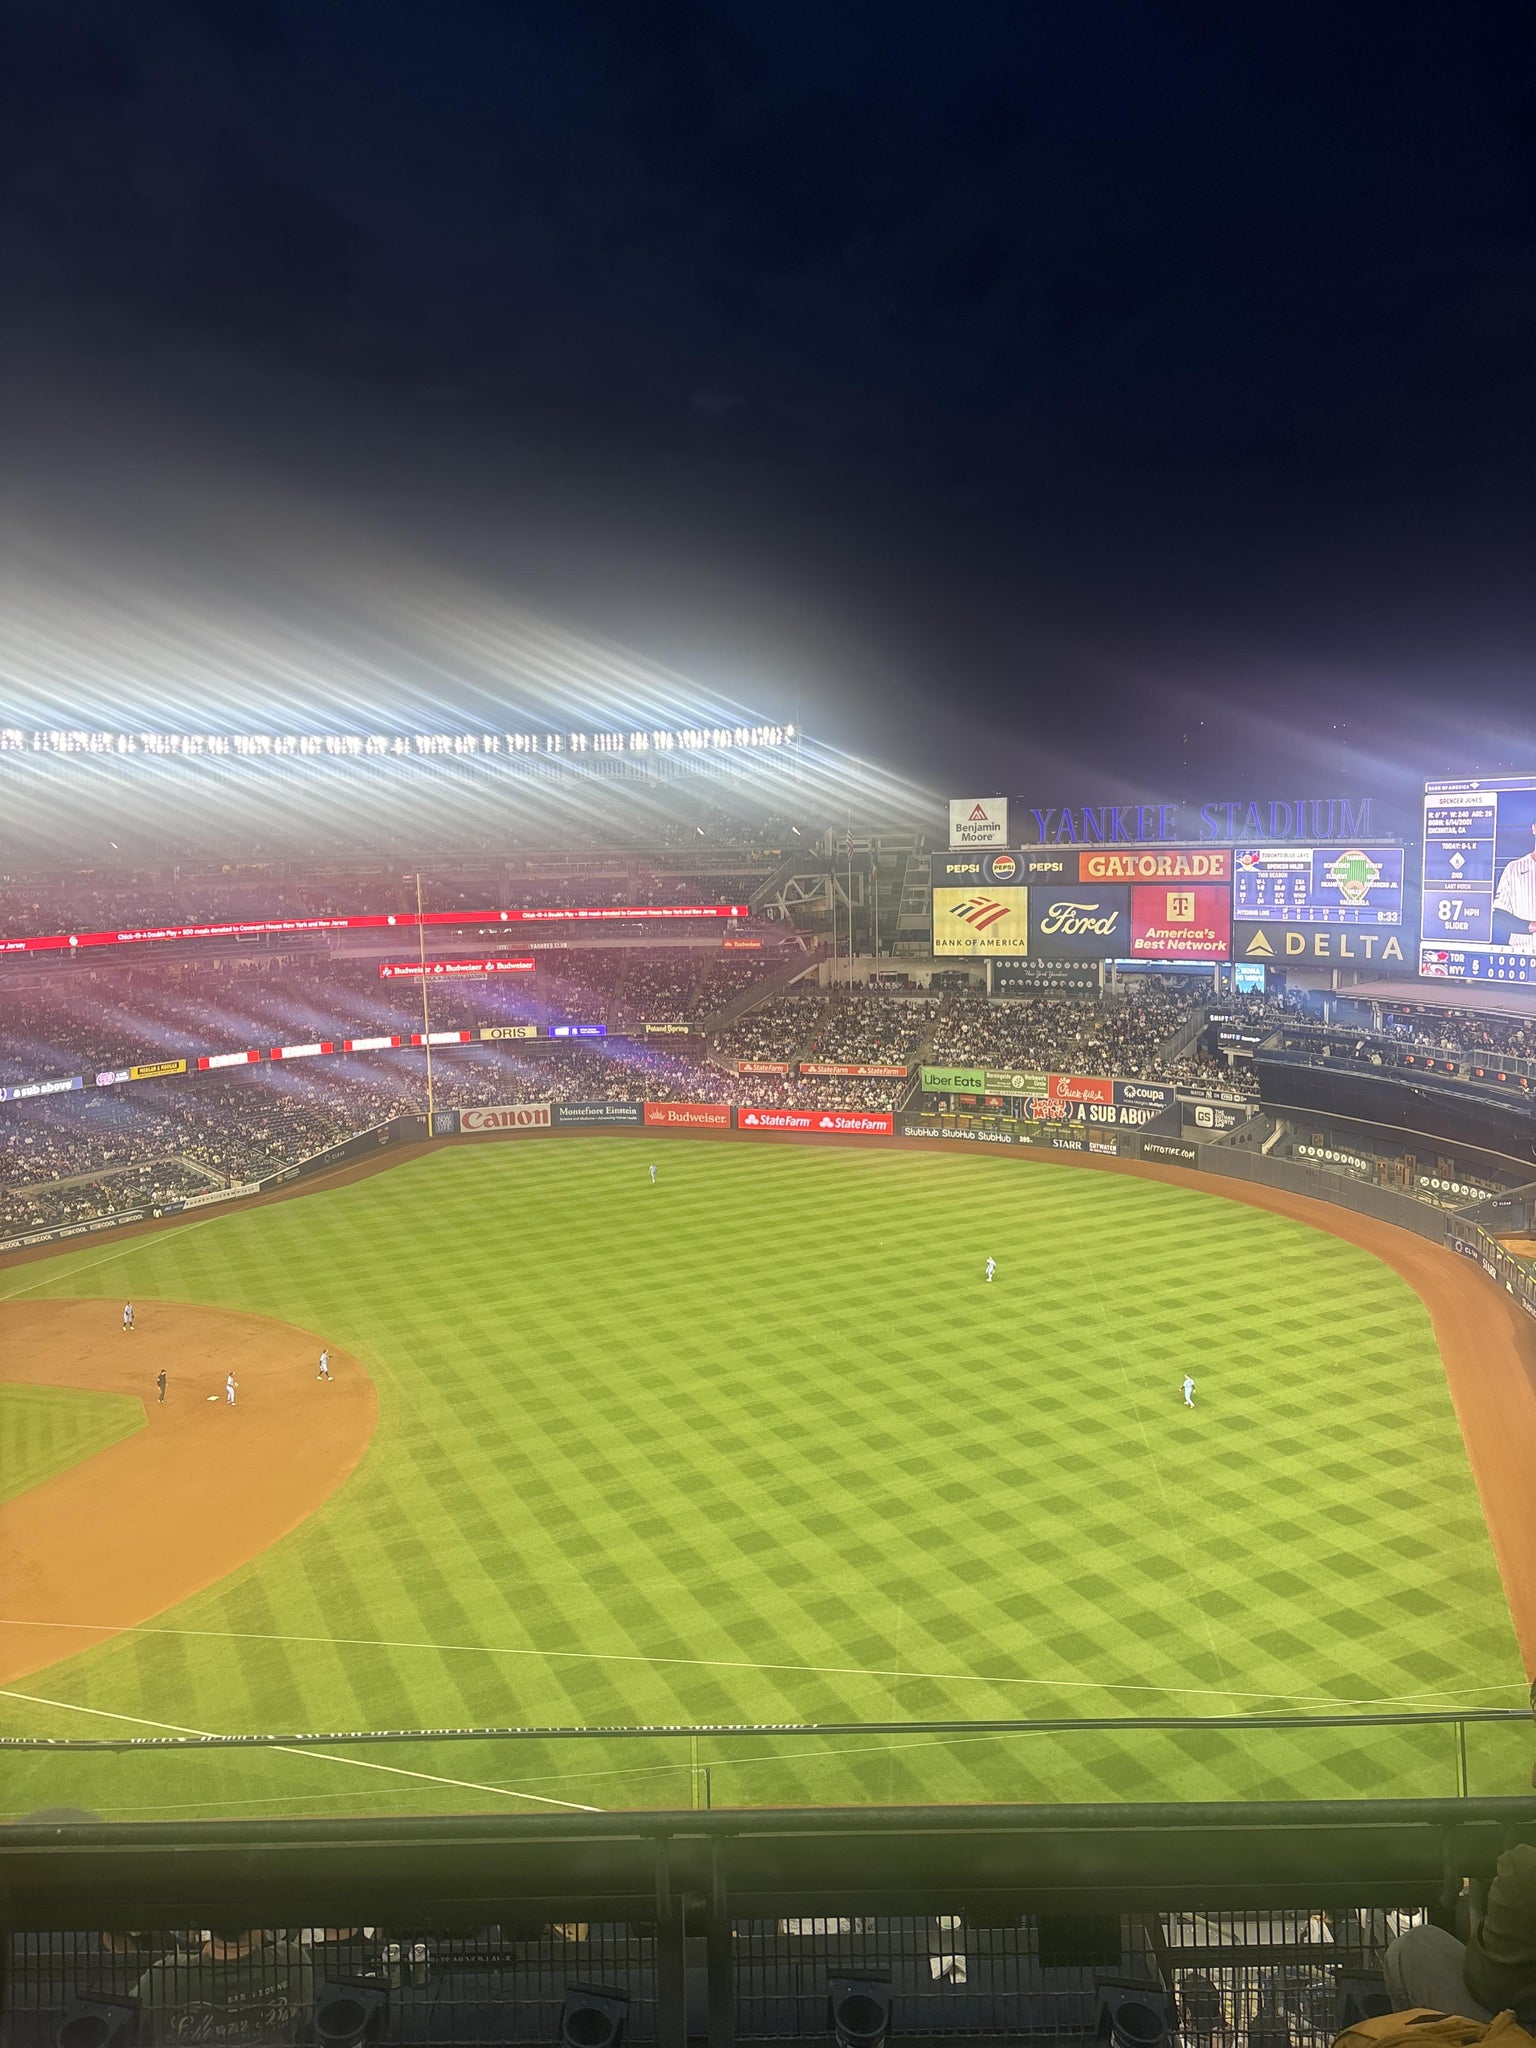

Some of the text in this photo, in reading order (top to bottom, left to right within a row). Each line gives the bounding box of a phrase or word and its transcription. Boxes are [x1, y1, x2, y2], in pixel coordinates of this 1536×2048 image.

[1440, 796, 1483, 805] SPENCER JONES
[1030, 798, 1374, 844] YANKEE STADIUM
[956, 822, 1001, 834] Benjamin
[961, 833, 993, 842] Moore
[946, 864, 980, 874] PEPSI
[1029, 862, 1063, 872] PEPSI
[1087, 855, 1224, 877] GATORADE
[16, 890, 49, 898] VODKA
[1173, 897, 1189, 916] T
[1438, 899, 1480, 921] 87 MPH
[1040, 902, 1119, 935] Ford
[1377, 911, 1398, 922] 8:33
[331, 919, 349, 927] Jersey
[1444, 922, 1469, 931] SLIDER
[1145, 927, 1216, 940] America's
[935, 939, 963, 947] BANK
[979, 939, 1025, 947] AMERICA
[1134, 939, 1228, 951] Best Network
[1285, 932, 1404, 961] DELTA
[496, 961, 533, 970] Budweiser
[1449, 953, 1536, 968] TOR 1 0 0 0 0
[1472, 960, 1479, 971] 5
[445, 964, 483, 972] Budweiser
[1449, 966, 1526, 980] NYY 0 0 0 0
[491, 1028, 526, 1038] ORIS
[645, 1024, 689, 1035] Poland Spring
[924, 1074, 952, 1086] Uber
[954, 1076, 982, 1088] Eats
[21, 1084, 41, 1096] sub
[41, 1080, 72, 1093] above
[1136, 1088, 1164, 1102] coupa
[559, 1106, 637, 1116] Montefiore Einstein
[1077, 1104, 1156, 1125] A SUB ABOV
[1198, 1111, 1211, 1122] GS
[461, 1109, 549, 1130] Canon
[904, 1127, 1011, 1143] StubHub StubHub StubHub
[1052, 1139, 1082, 1150] STARR
[1143, 1143, 1195, 1160] NITTOTIRE.COM
